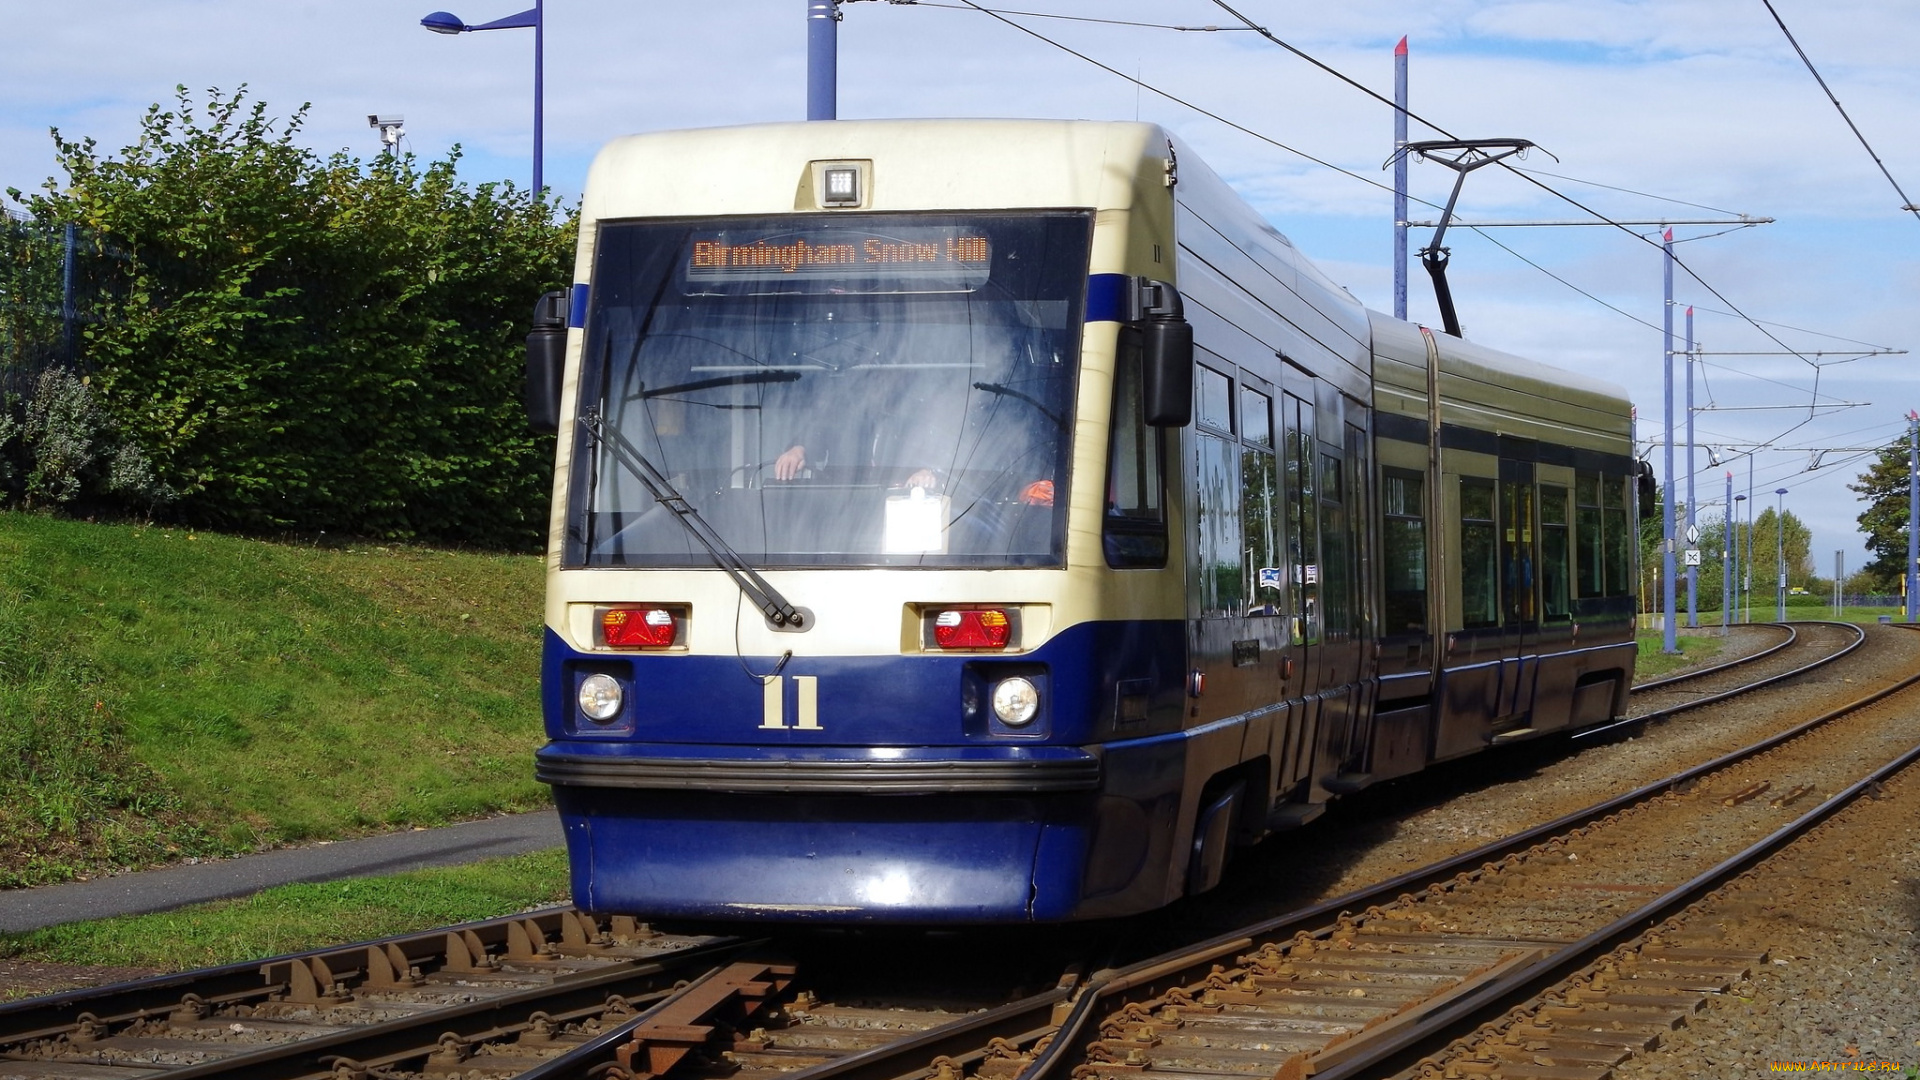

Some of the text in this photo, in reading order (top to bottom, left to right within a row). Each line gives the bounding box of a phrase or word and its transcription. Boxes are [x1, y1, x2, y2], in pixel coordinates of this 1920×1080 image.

[694, 236, 987, 273] Birmingham Snow Hill
[758, 675, 824, 730] 11
